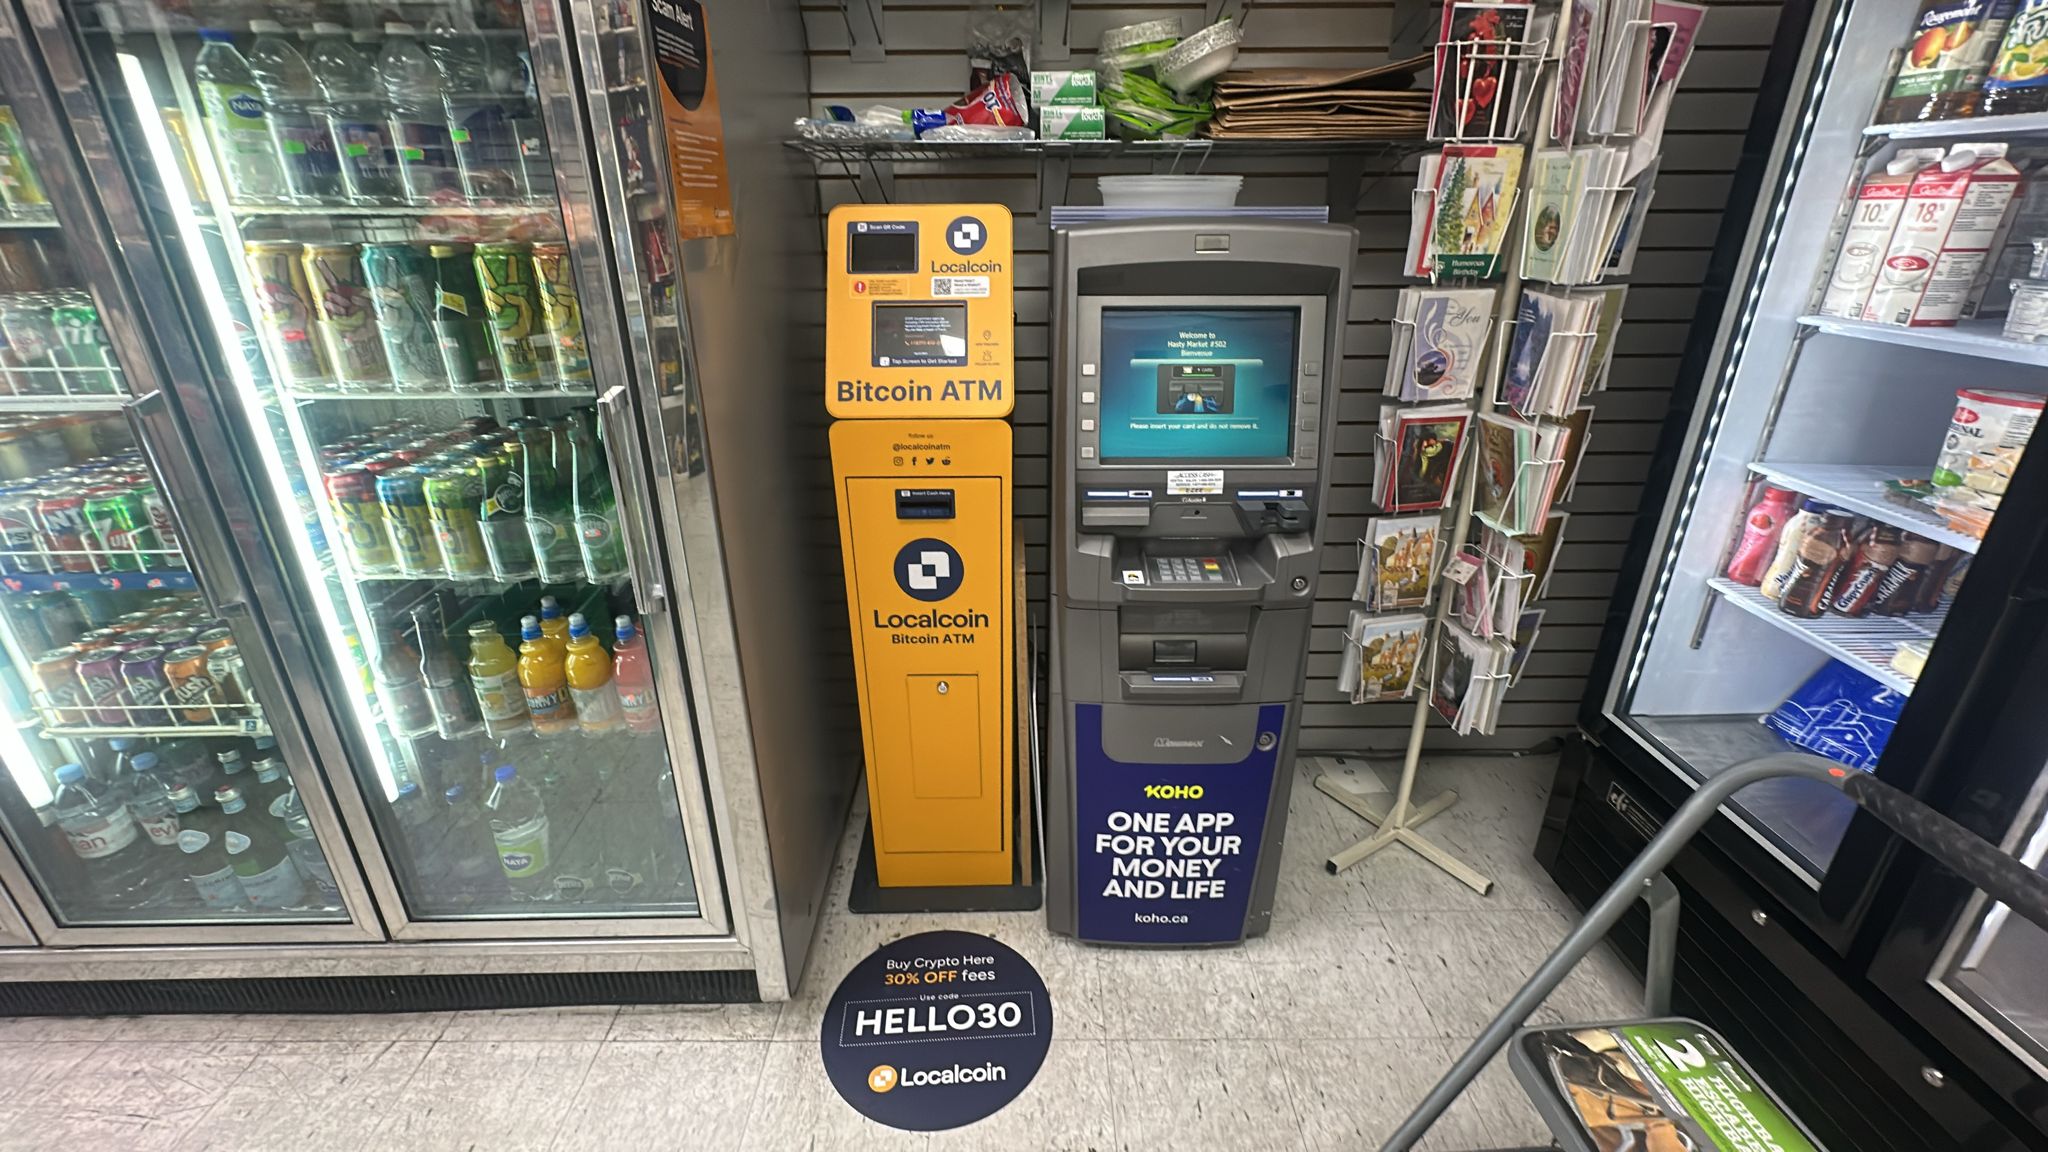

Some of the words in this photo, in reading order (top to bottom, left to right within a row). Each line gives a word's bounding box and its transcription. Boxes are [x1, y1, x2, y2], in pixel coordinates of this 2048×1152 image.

[931, 260, 1002, 274] Localcoin
[1452, 259, 1485, 267] Humorous
[1453, 268, 1479, 276] Birthday
[1168, 341, 1185, 349] Hasty
[837, 380, 932, 402] Bitcoin
[940, 380, 1002, 401] ATM
[892, 443, 951, 451] @localcoinatm
[873, 608, 989, 629] Localcoin
[891, 633, 939, 644] Bitcoin
[942, 633, 975, 644] ATM
[1144, 784, 1204, 799] KOHO
[1107, 811, 1171, 833] ONE
[1174, 812, 1235, 833] APP
[1096, 833, 1155, 855] FOR
[1160, 835, 1242, 856] YOUR
[1112, 858, 1222, 878] MONEY
[1102, 880, 1165, 899] AND
[1170, 879, 1226, 899] LIFE
[1134, 913, 1188, 924] koho.ca
[886, 959, 911, 970] Buy
[914, 956, 959, 969] Crypto
[963, 954, 995, 965] Here
[884, 972, 920, 985] 30%
[924, 970, 958, 984] OFF
[962, 968, 996, 982] fees
[937, 992, 960, 1000] code
[855, 1001, 1022, 1037] HELLO30
[1652, 1038, 1706, 1072] 2
[900, 1062, 1007, 1088] Localcoin
